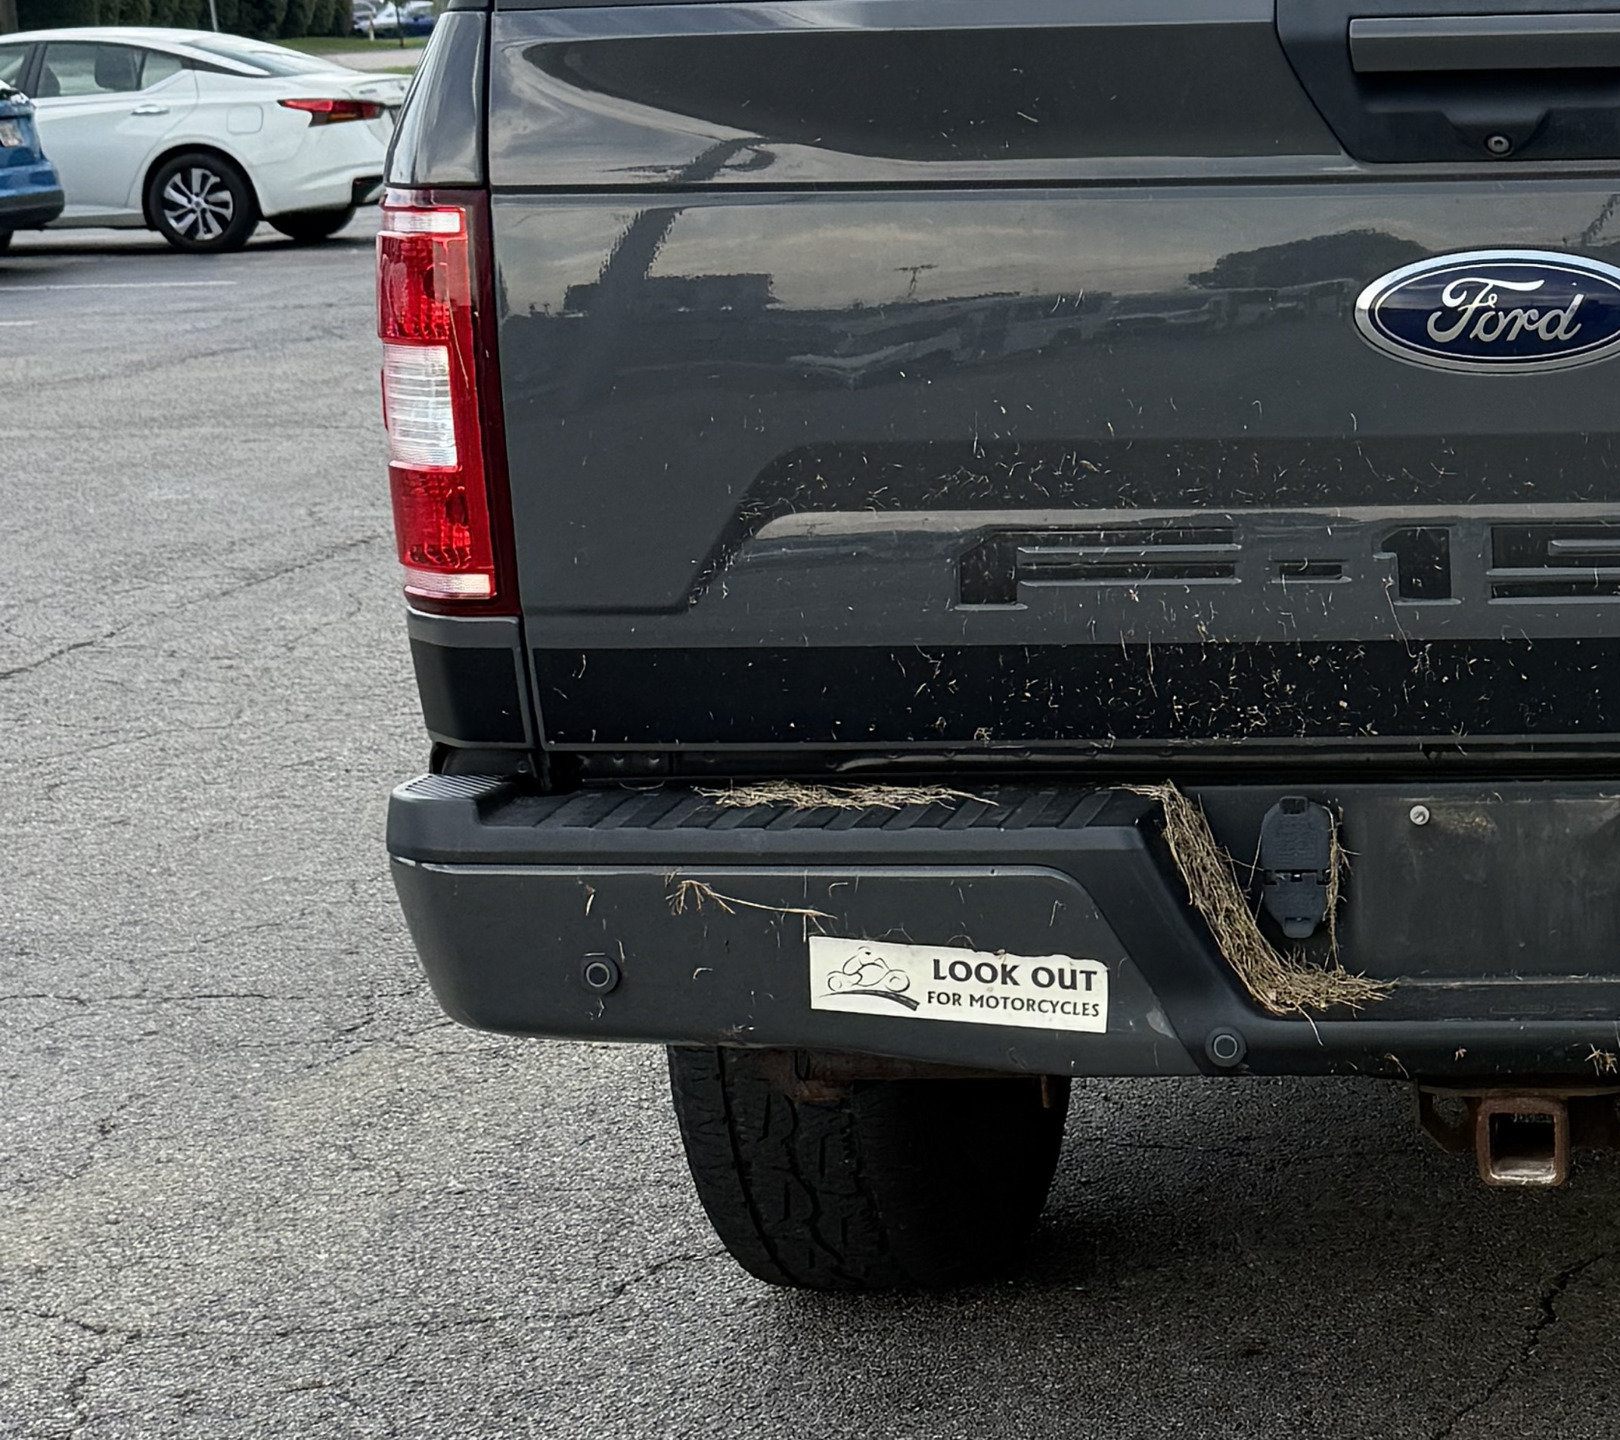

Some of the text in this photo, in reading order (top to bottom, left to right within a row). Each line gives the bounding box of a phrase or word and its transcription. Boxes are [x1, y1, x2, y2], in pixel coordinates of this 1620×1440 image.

[1426, 276, 1586, 343] Ford
[932, 958, 1098, 992] LOOK OUT
[927, 990, 1101, 1018] FOR MOTORCYCLES
